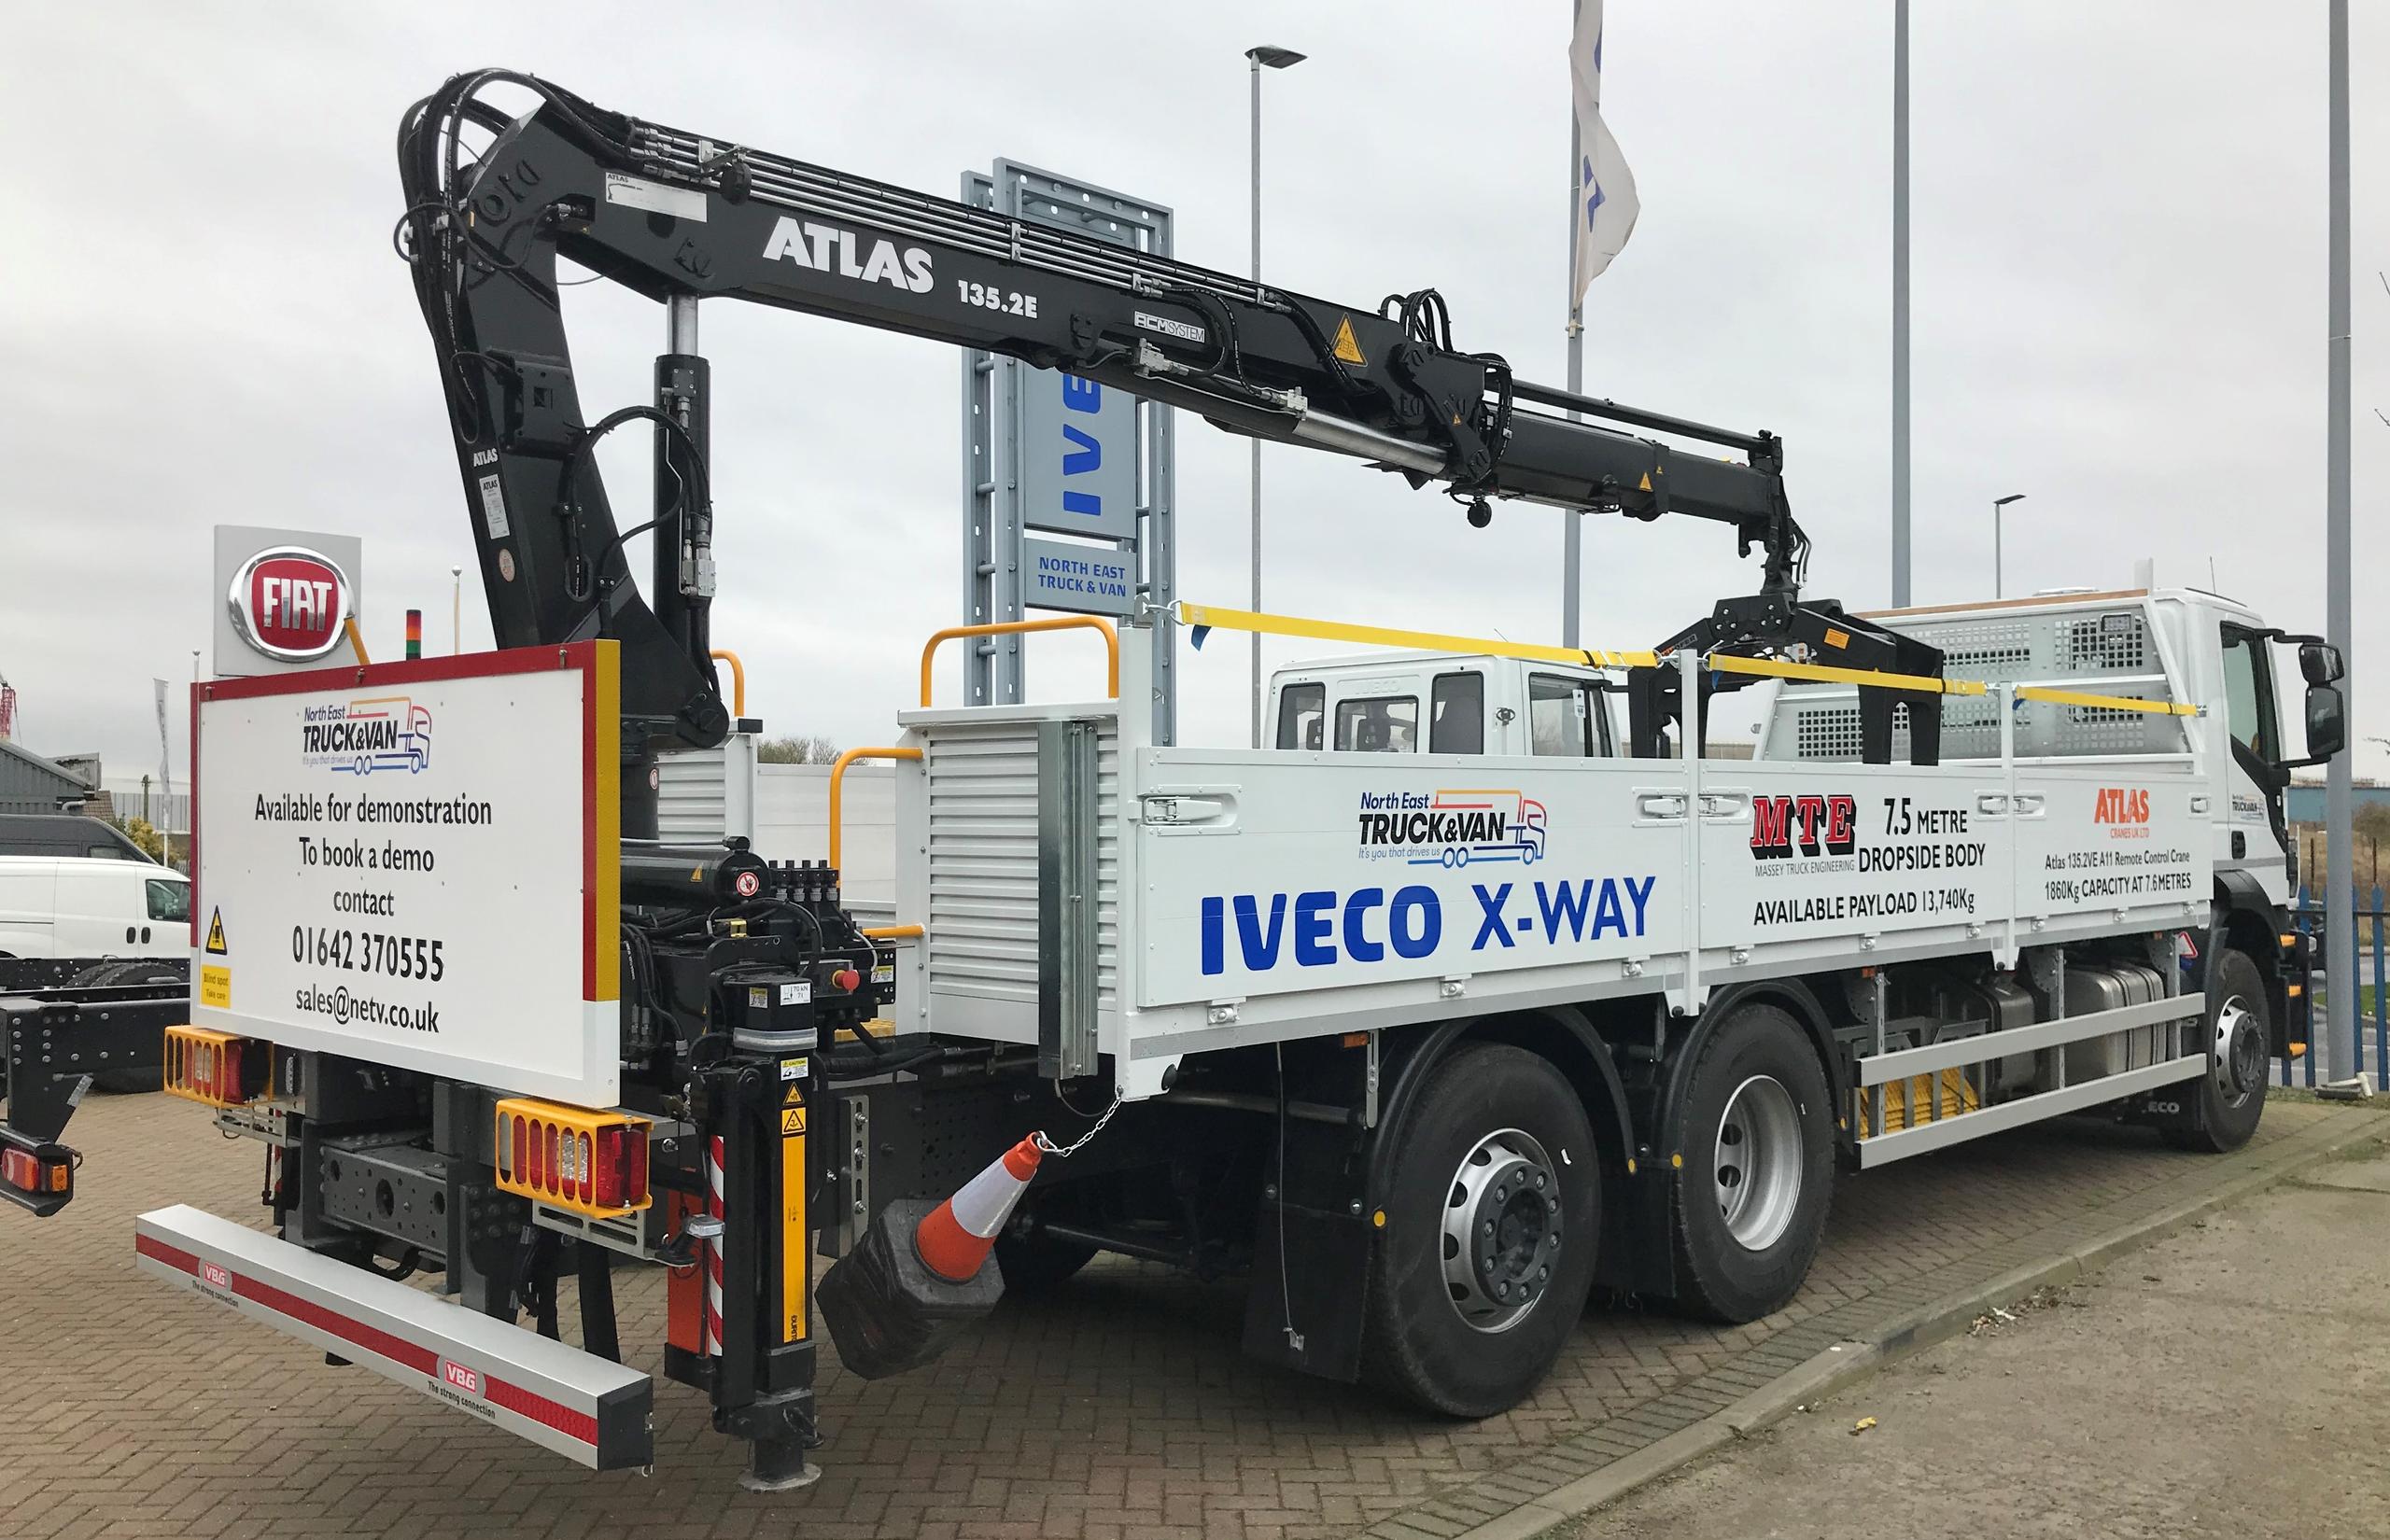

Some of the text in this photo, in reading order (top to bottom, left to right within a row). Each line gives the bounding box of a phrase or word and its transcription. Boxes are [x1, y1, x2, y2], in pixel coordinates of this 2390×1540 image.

[763, 216, 935, 294] ATLAS
[958, 280, 1038, 318] 135.2E
[473, 448, 499, 467] ATLAS
[1062, 372, 1102, 516] IVE
[483, 480, 498, 491] ATLAS
[1039, 556, 1126, 580] NORTH EAST
[1038, 574, 1127, 597] TRUCK & VAN
[263, 577, 332, 632] FIAT
[304, 705, 345, 721] North East
[303, 721, 398, 752] TRUCK&VAN
[310, 758, 319, 767] you
[320, 756, 330, 764] that
[330, 756, 346, 764] drives
[255, 792, 492, 825] Available for demonstration
[1360, 791, 1430, 809] North East
[2094, 788, 2150, 824] ATLAS
[1359, 812, 1506, 845] TRUCK&VAN
[1750, 794, 1857, 861] MTE
[1884, 797, 1967, 835] 7.5 METRE
[2110, 827, 2150, 839] CRANES UK LTD
[299, 836, 434, 872] To book a demo
[1358, 847, 1370, 859] It's
[1371, 850, 1387, 861] you
[1389, 847, 1404, 858] that
[1406, 846, 1429, 858] drives
[1859, 843, 1986, 873] DROPSIDE BODY
[2046, 848, 2190, 870] Atlas 135.2VE A11 Remote Control Crane
[1755, 860, 1855, 877] MASSEY TRUCK ENGINEERING
[333, 889, 394, 917] contact
[2045, 880, 2080, 903] 1860Kg
[2082, 877, 2130, 898] CAPACITY
[2131, 876, 2144, 893] AT
[1753, 888, 1975, 926] AVAILABLE PAYLOAD 13,740Kg
[1202, 875, 1656, 975] IVECO X-WAY
[292, 925, 444, 982] 01642 370555
[204, 973, 216, 985] Blind
[296, 983, 439, 1033] sales@netv.co.uk
[2147, 1101, 2181, 1113] ECO
[205, 1265, 225, 1285] VBG
[447, 1364, 476, 1390] VBG
[428, 1381, 496, 1419] The strong connection
